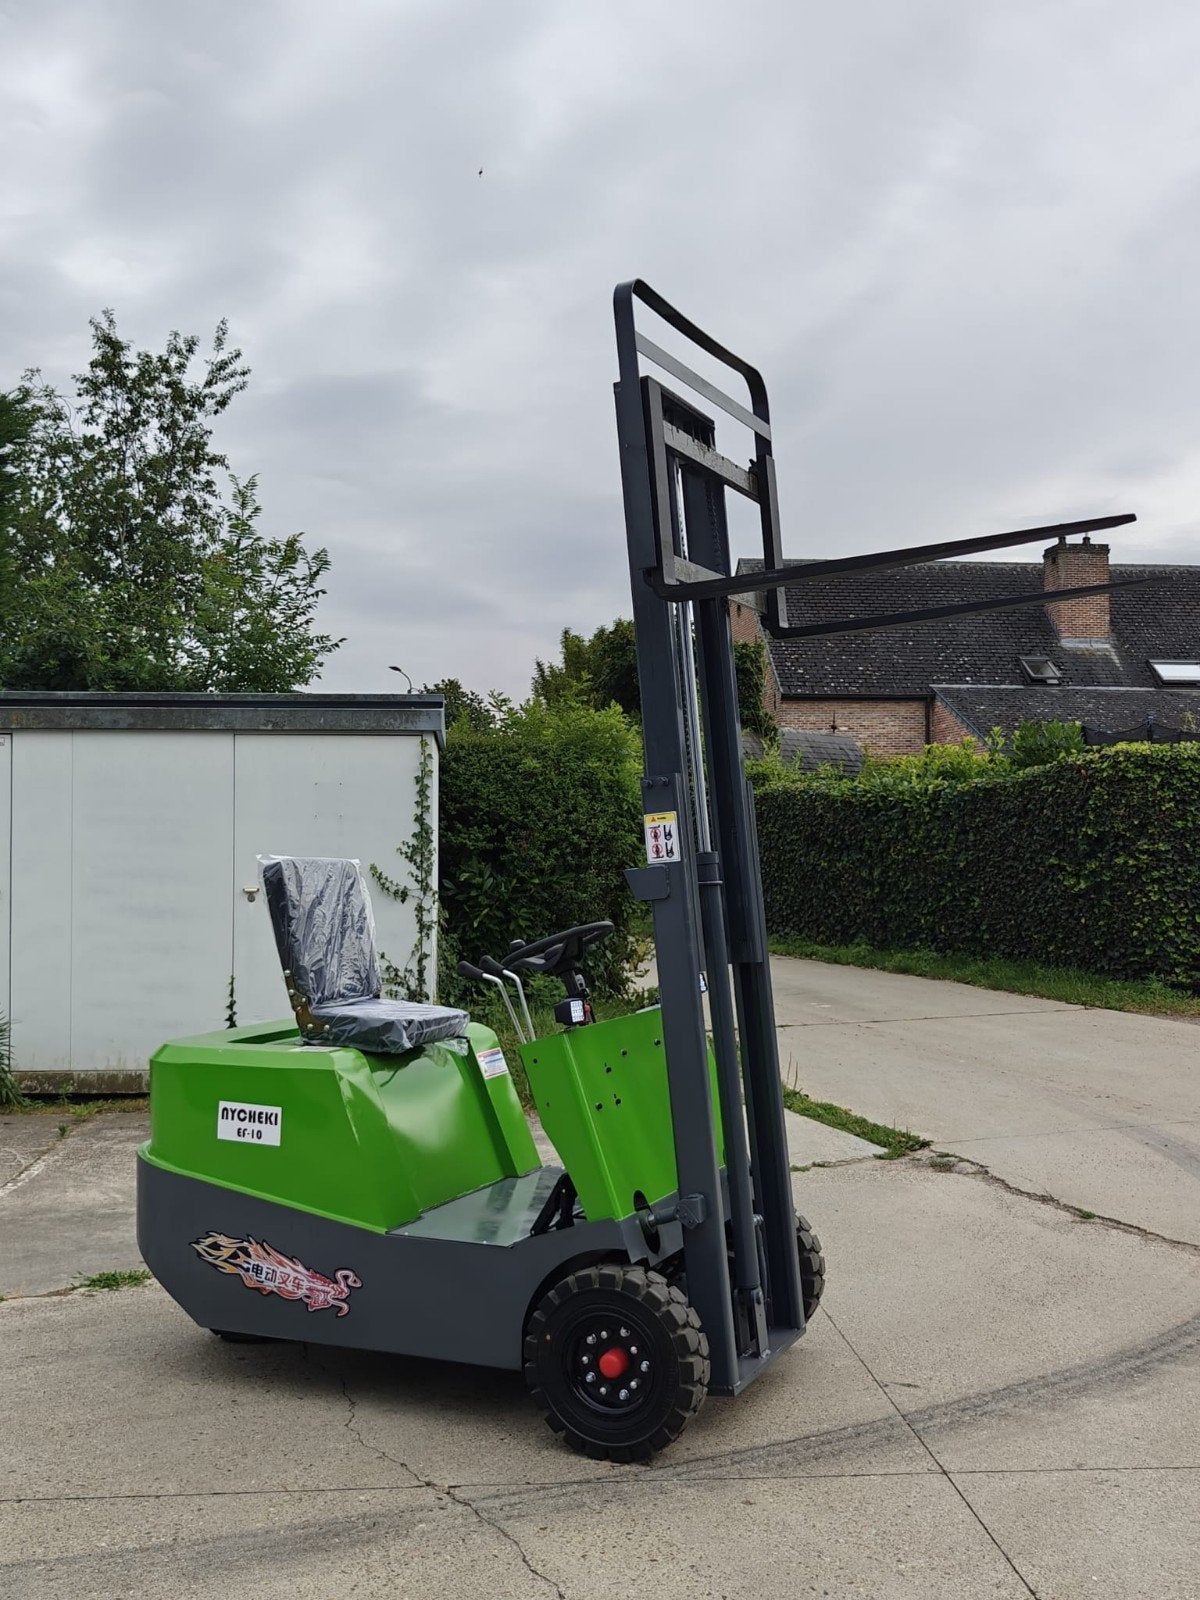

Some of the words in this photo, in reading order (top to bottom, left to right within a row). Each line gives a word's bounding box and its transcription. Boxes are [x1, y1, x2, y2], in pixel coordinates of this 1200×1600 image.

[221, 1106, 279, 1126] NYCHEKI
[236, 1127, 263, 1140] EF-10
[251, 1263, 305, 1291] 电动叉车
